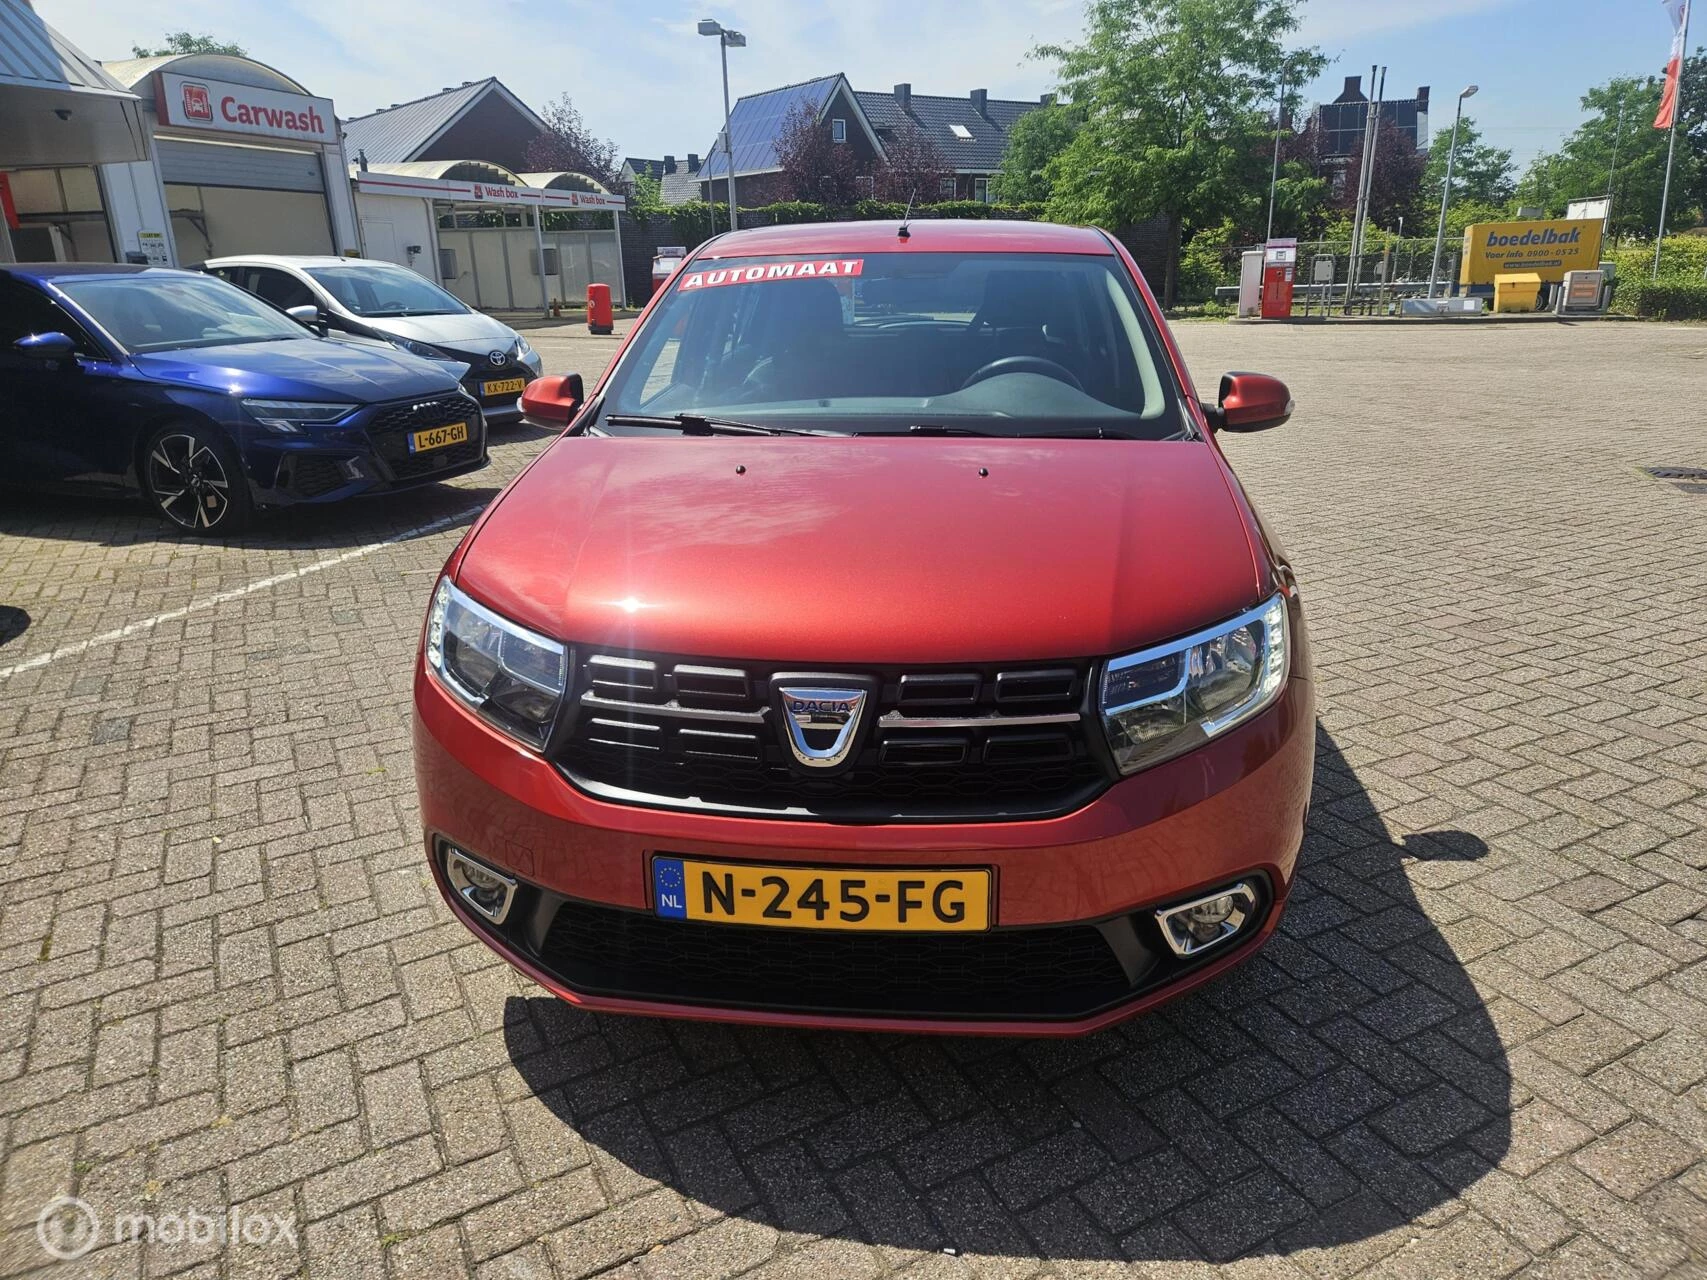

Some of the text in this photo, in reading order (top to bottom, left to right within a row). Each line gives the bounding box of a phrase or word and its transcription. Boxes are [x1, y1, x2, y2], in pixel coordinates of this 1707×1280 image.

[221, 96, 325, 134] Carwash
[485, 186, 519, 199] Wash box
[580, 194, 606, 205] Wash box
[1486, 227, 1581, 247] boedelbak
[1485, 251, 1504, 259] Voor
[1506, 250, 1524, 258] info
[684, 260, 860, 288] AUTOMAAT
[486, 379, 522, 394] KX-722-V
[418, 426, 465, 448] L-667-GH
[792, 700, 850, 713] DACIA
[661, 893, 683, 909] NL
[701, 870, 965, 924] N-245-FG
